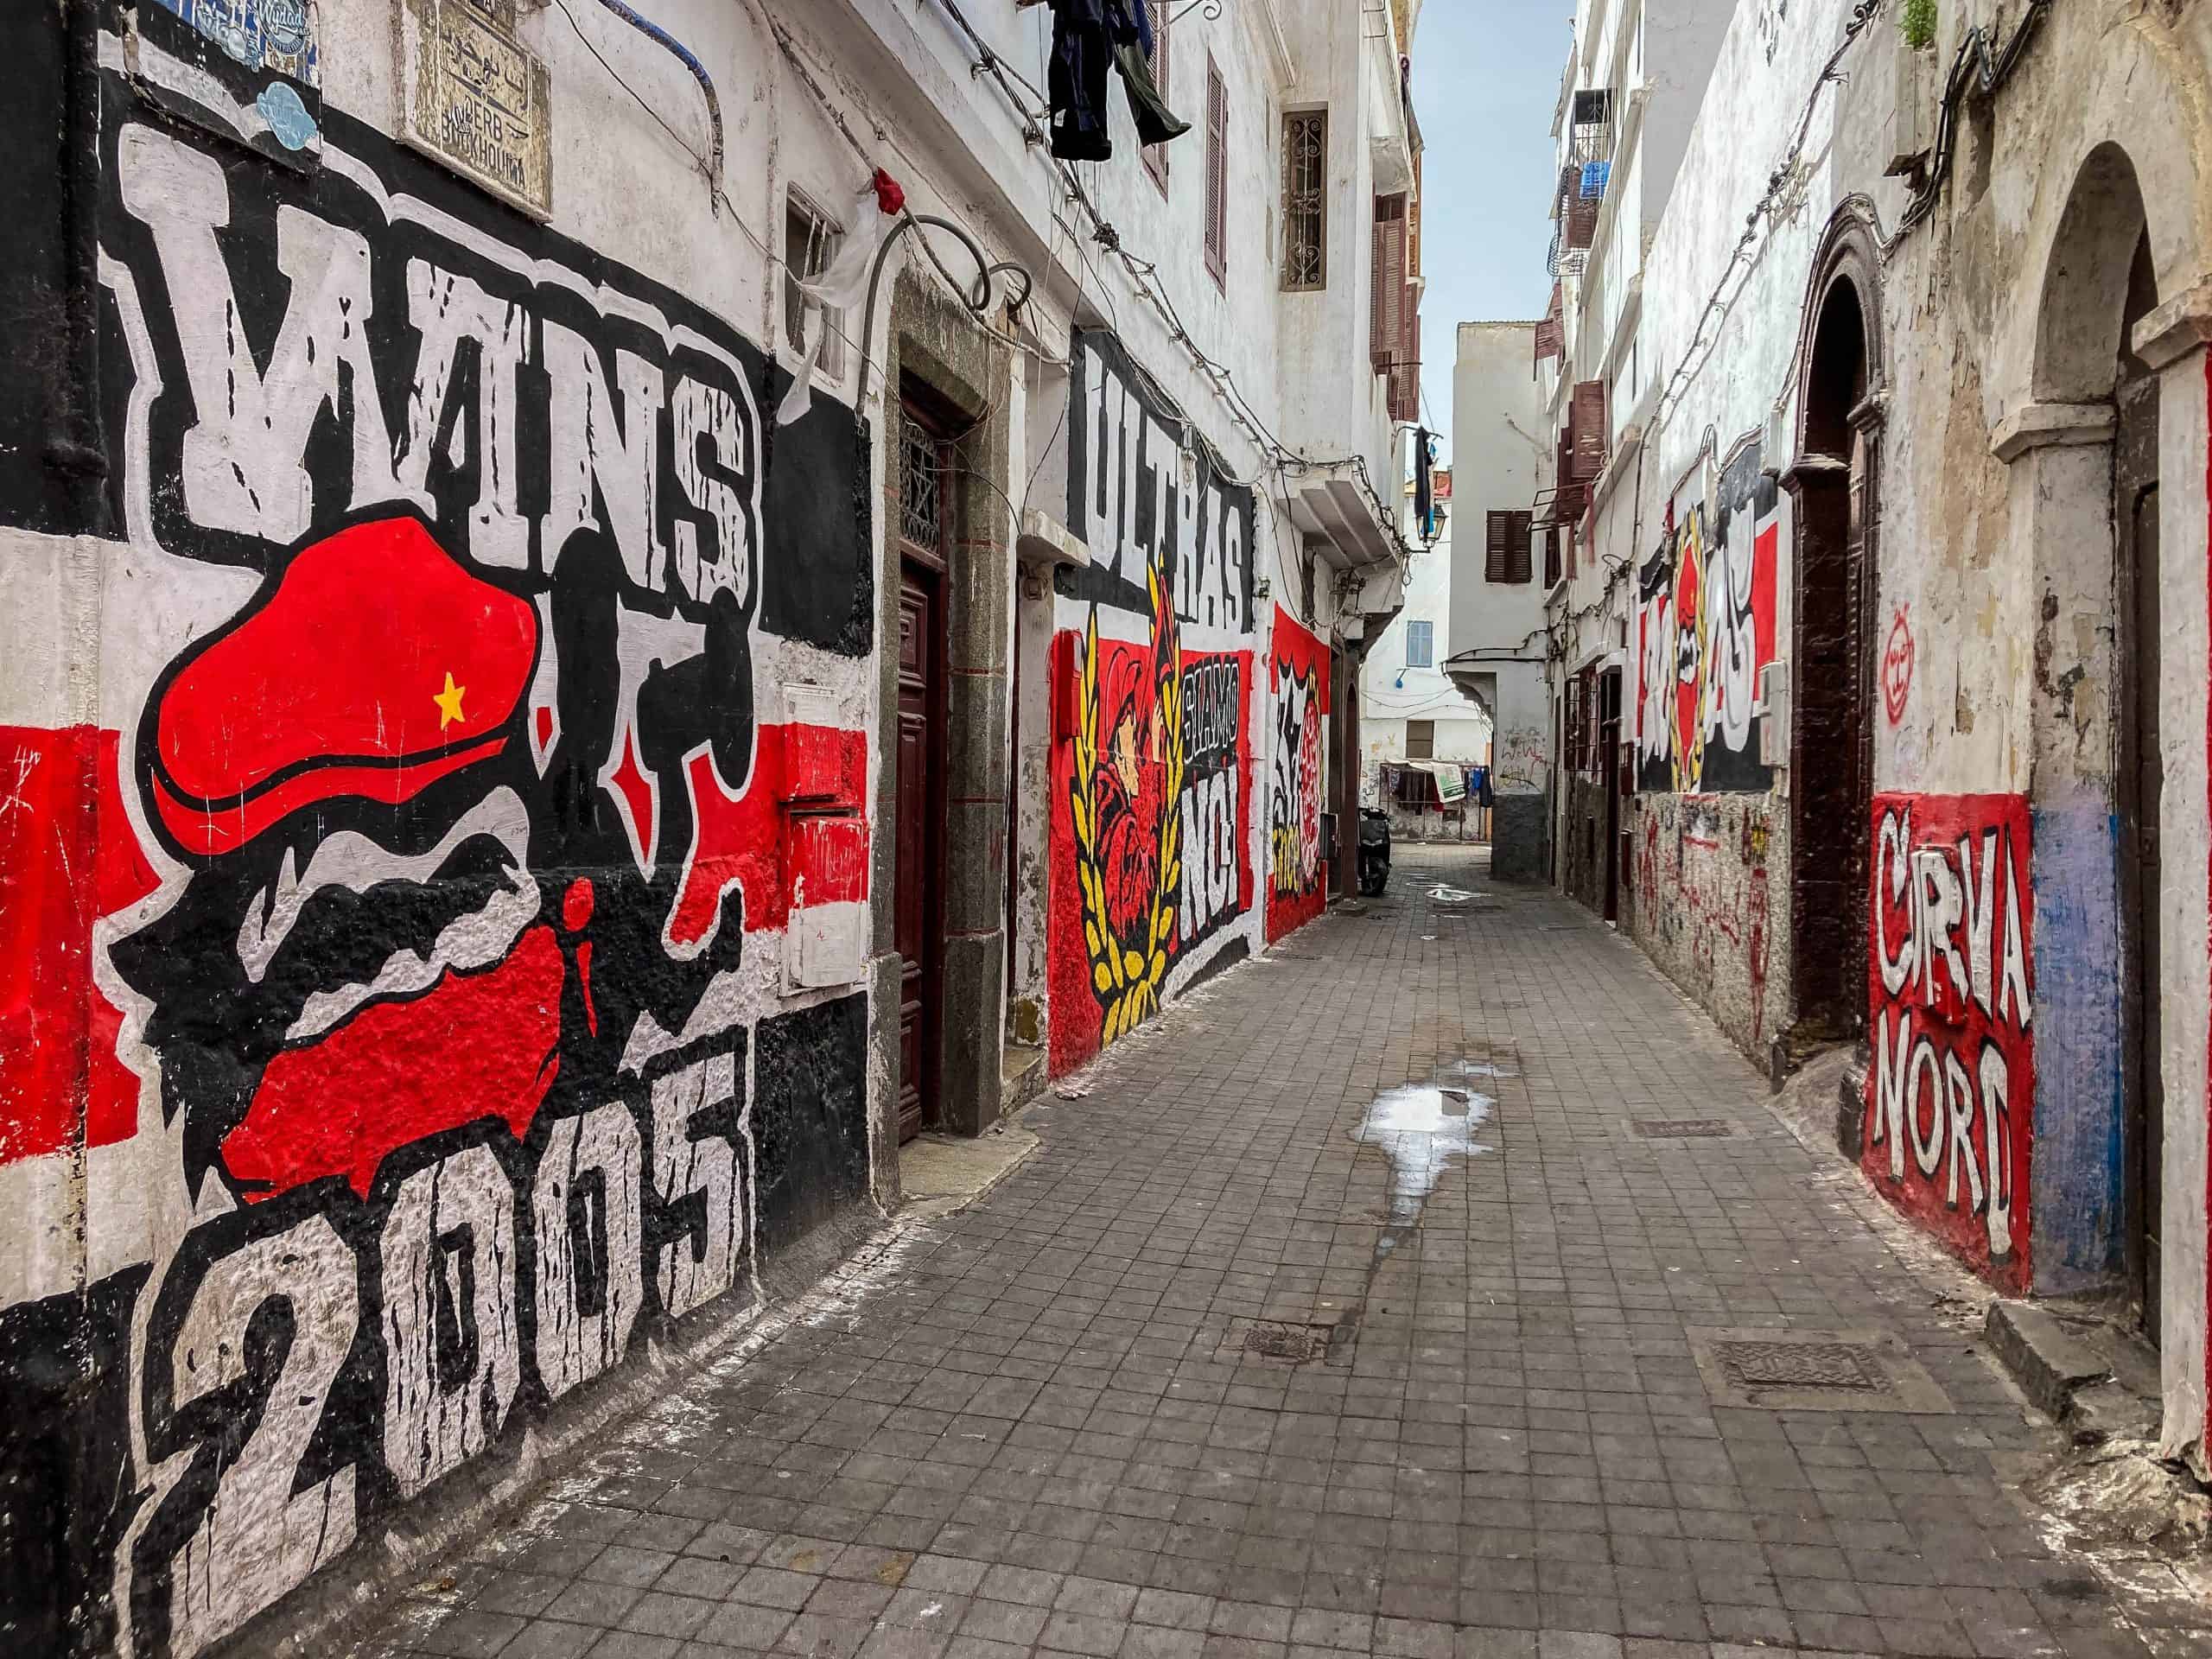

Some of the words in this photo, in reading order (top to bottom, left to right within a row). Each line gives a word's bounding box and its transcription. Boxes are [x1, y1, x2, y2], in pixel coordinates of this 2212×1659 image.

[464, 95, 503, 143] DERB
[1084, 343, 1244, 632] ULTRAS
[1181, 662, 1240, 765] SIAMO
[1873, 1007, 2012, 1263] NORD
[168, 1050, 745, 1657] 2005
